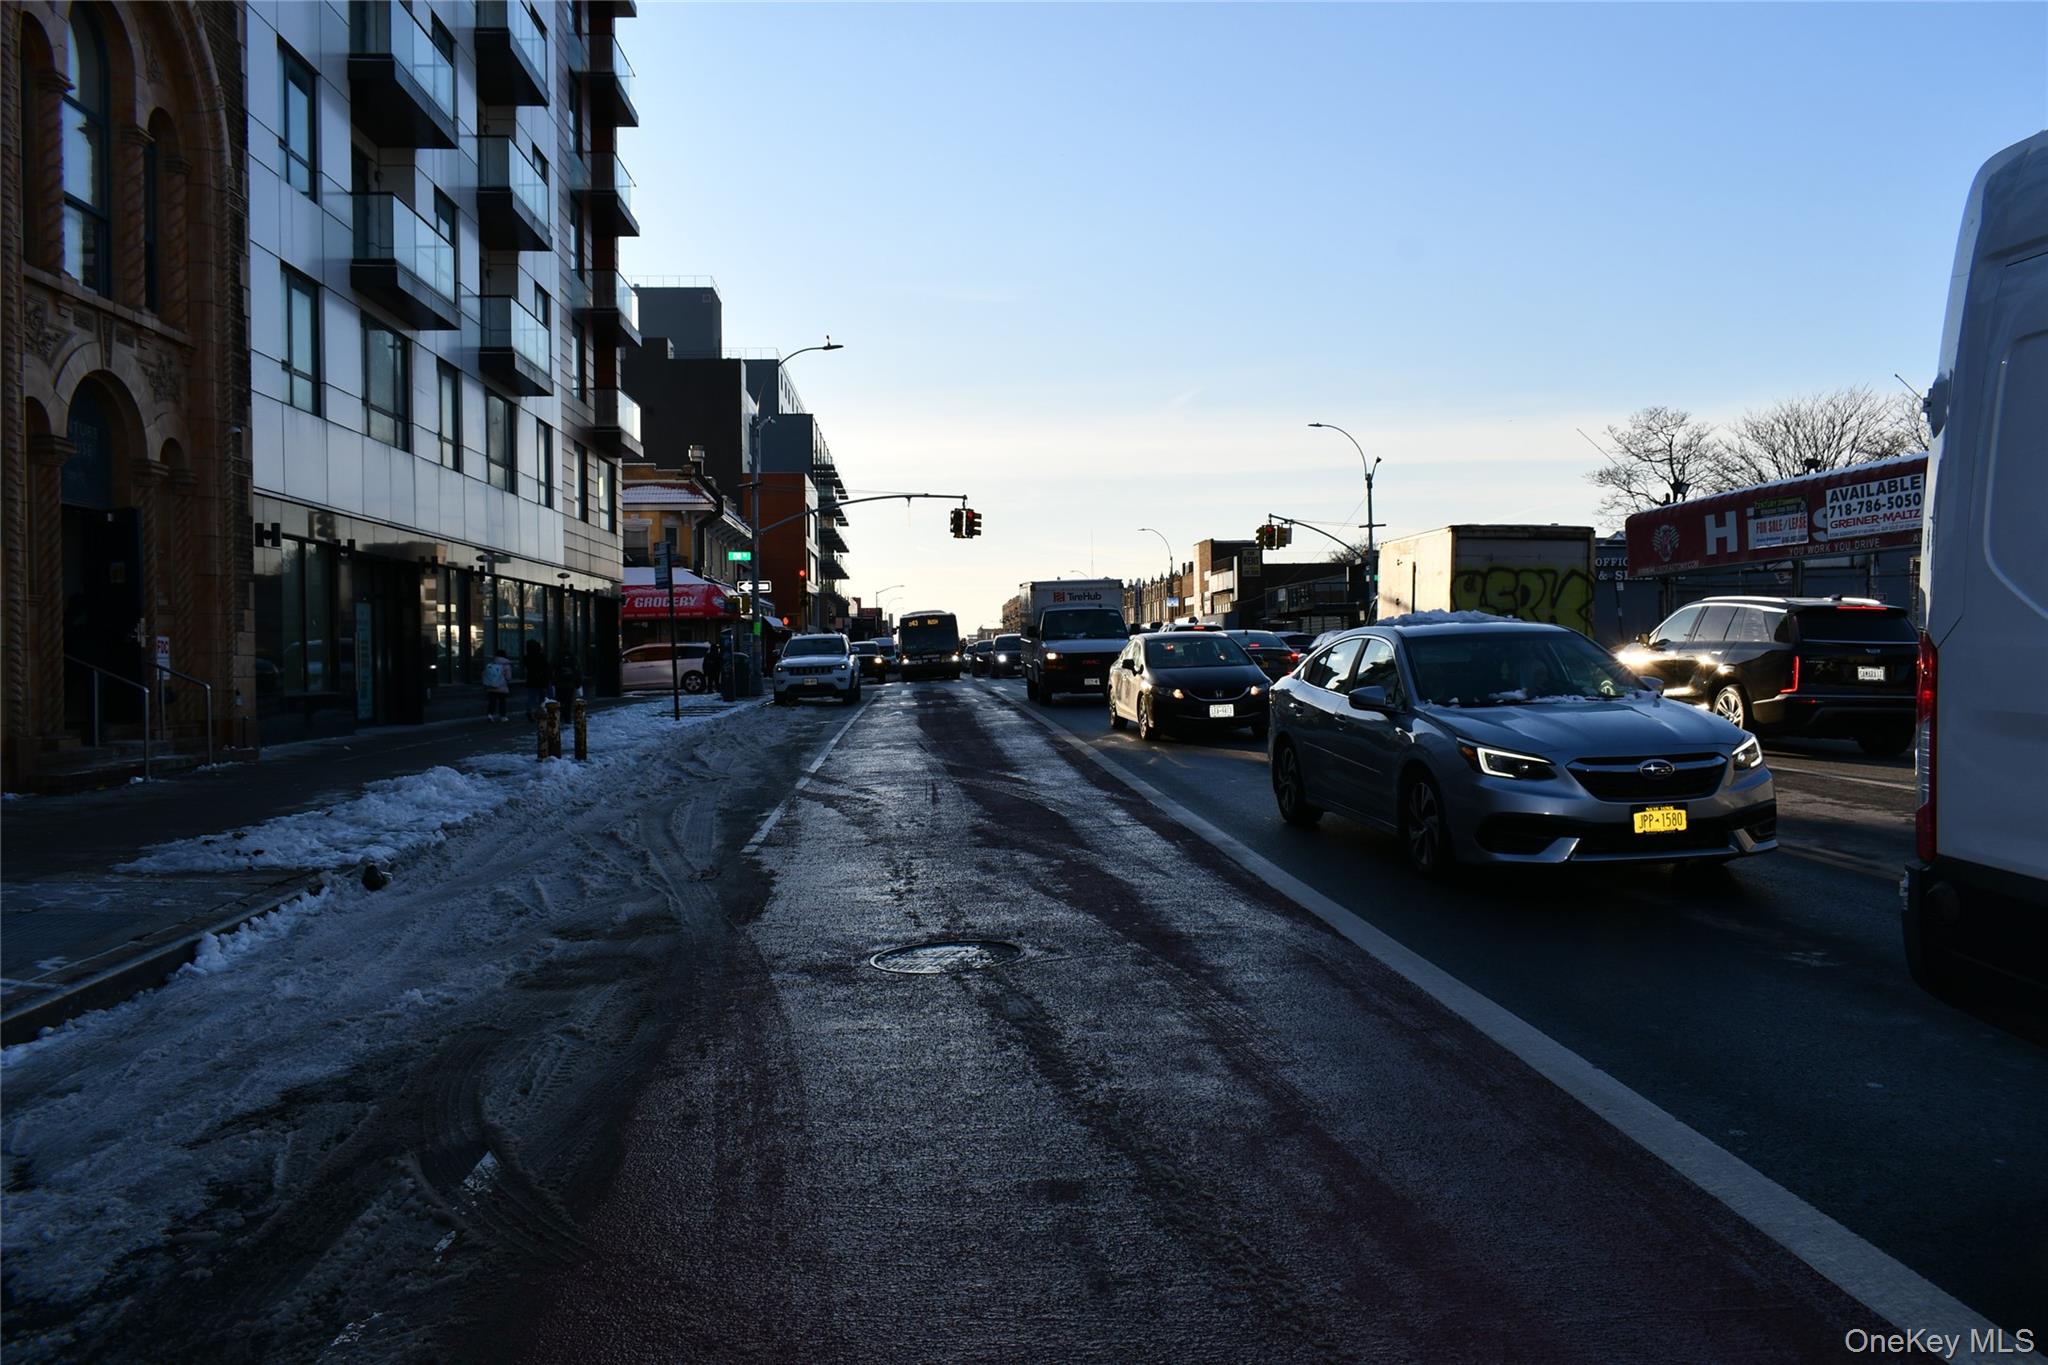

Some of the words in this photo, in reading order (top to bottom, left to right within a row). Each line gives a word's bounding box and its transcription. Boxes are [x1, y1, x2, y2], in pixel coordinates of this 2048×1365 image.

[1829, 475, 1921, 503] AVAILABLE
[1829, 492, 1921, 518] 718-786-5050
[1756, 520, 1767, 534] FOR
[1830, 508, 1920, 529] GREINER-MALTZ
[1789, 547, 1804, 556] YOU
[1807, 544, 1831, 554] WORK
[1834, 541, 1850, 552] YOU
[1855, 538, 1880, 549] DRIVE
[1595, 557, 1628, 567] OFFIC
[634, 595, 697, 608] GROCERY
[1067, 592, 1102, 601] TireHub
[1639, 812, 1683, 830] JPP-1580
